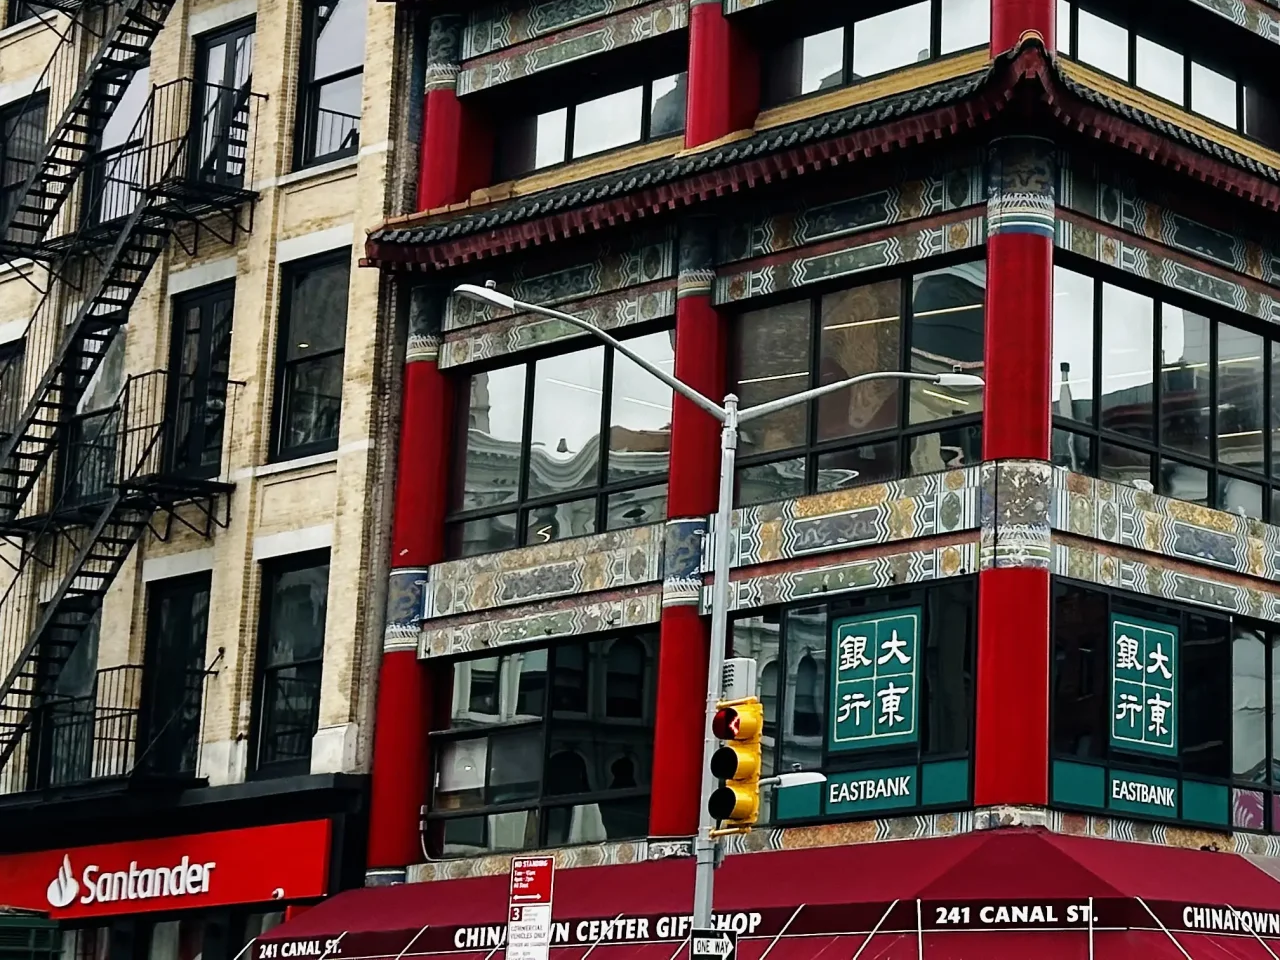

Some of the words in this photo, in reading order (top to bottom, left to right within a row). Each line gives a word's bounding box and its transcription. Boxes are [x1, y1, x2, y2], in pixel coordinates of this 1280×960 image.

[836, 634, 873, 727] 銀行
[877, 629, 911, 728] 大東
[1115, 633, 1144, 728] 銀行
[1145, 642, 1173, 737] 大東
[829, 775, 911, 804] EASTBANK
[1111, 779, 1175, 808] EASTBANK
[80, 855, 217, 905] Santander
[511, 907, 520, 921] 3
[576, 914, 649, 942] CENTER
[935, 906, 970, 924] 241
[979, 905, 1059, 924] CANAL
[1066, 904, 1099, 923] ST.
[1182, 906, 1280, 934] CHINATOWN
[259, 944, 278, 959] 241
[281, 941, 321, 957] CANAL
[697, 940, 710, 953] ONE
[715, 941, 730, 953] WAY
